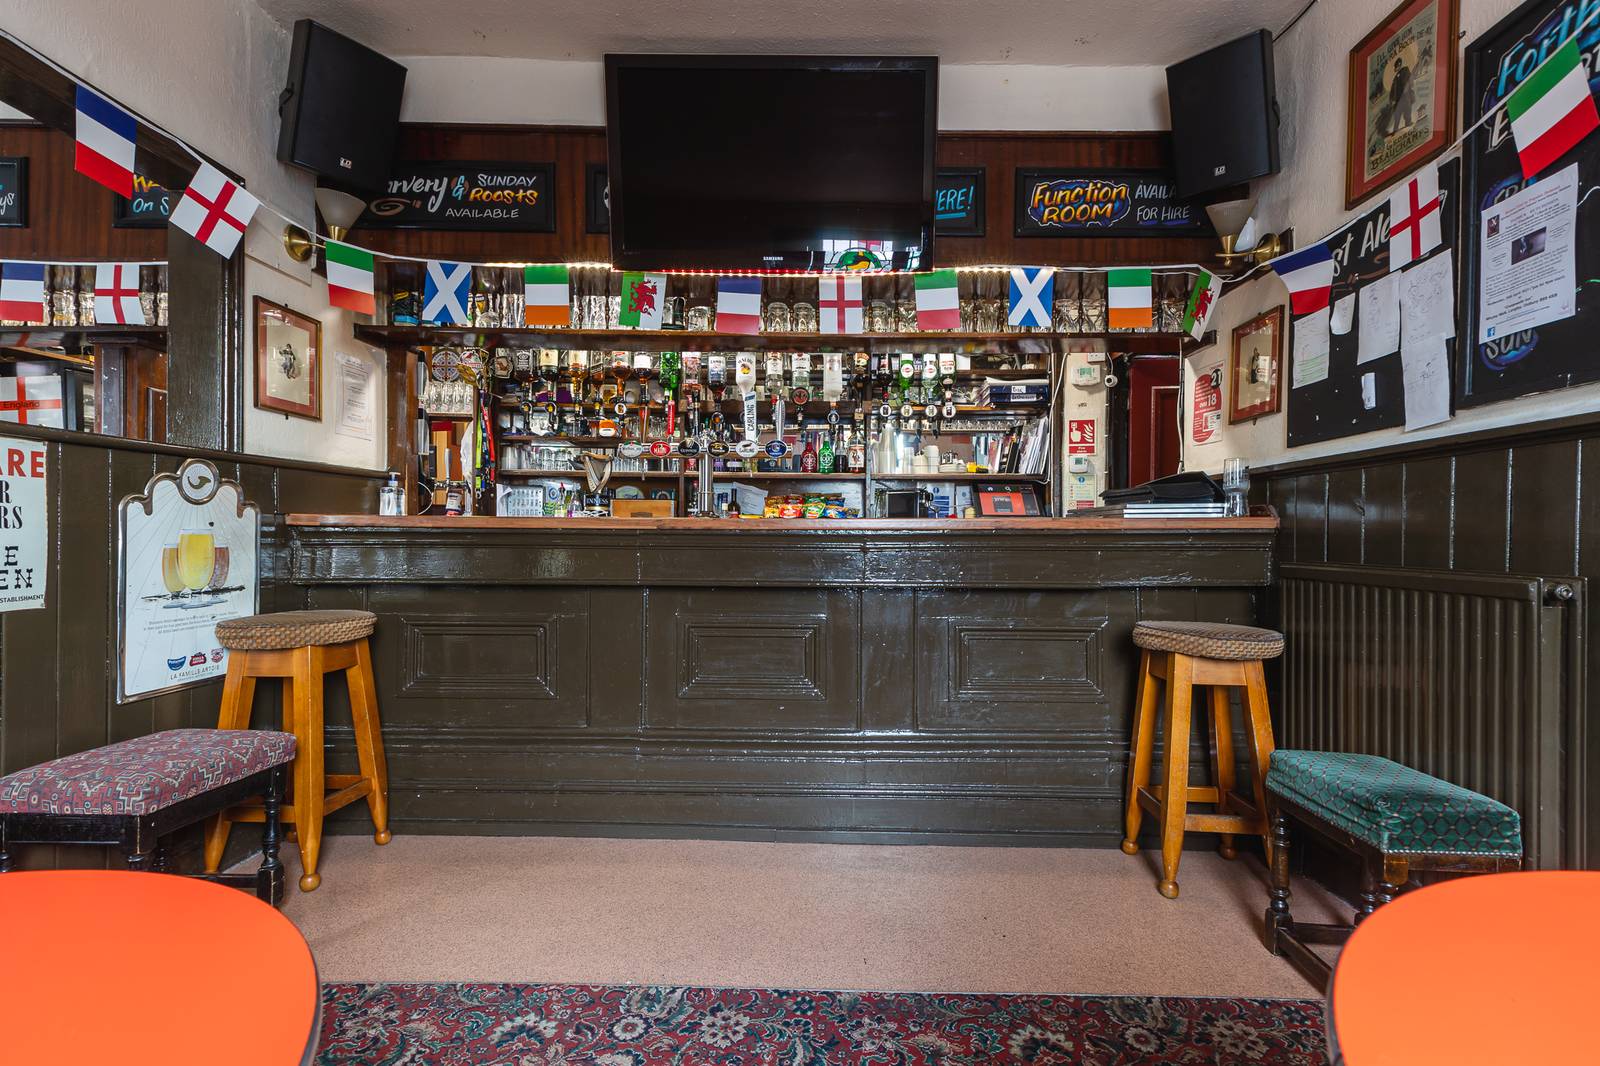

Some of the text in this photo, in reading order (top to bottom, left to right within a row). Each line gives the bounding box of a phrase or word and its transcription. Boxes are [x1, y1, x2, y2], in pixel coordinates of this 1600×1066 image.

[477, 173, 537, 187] SUNDAY
[0, 192, 15, 216] ys
[133, 196, 169, 216] On S
[1033, 182, 1127, 209] Function
[445, 207, 520, 218] AVAILABLE
[1042, 202, 1114, 223] ROOM
[1136, 205, 1190, 221] FOR HIRE
[1208, 393, 1217, 407] 18
[746, 404, 755, 432] CARLING
[0, 448, 45, 478] RE
[0, 480, 12, 504] R
[0, 505, 23, 530] RS
[4, 545, 19, 566] E
[0, 568, 33, 589] EN
[0, 594, 44, 603] STABLISHMENT
